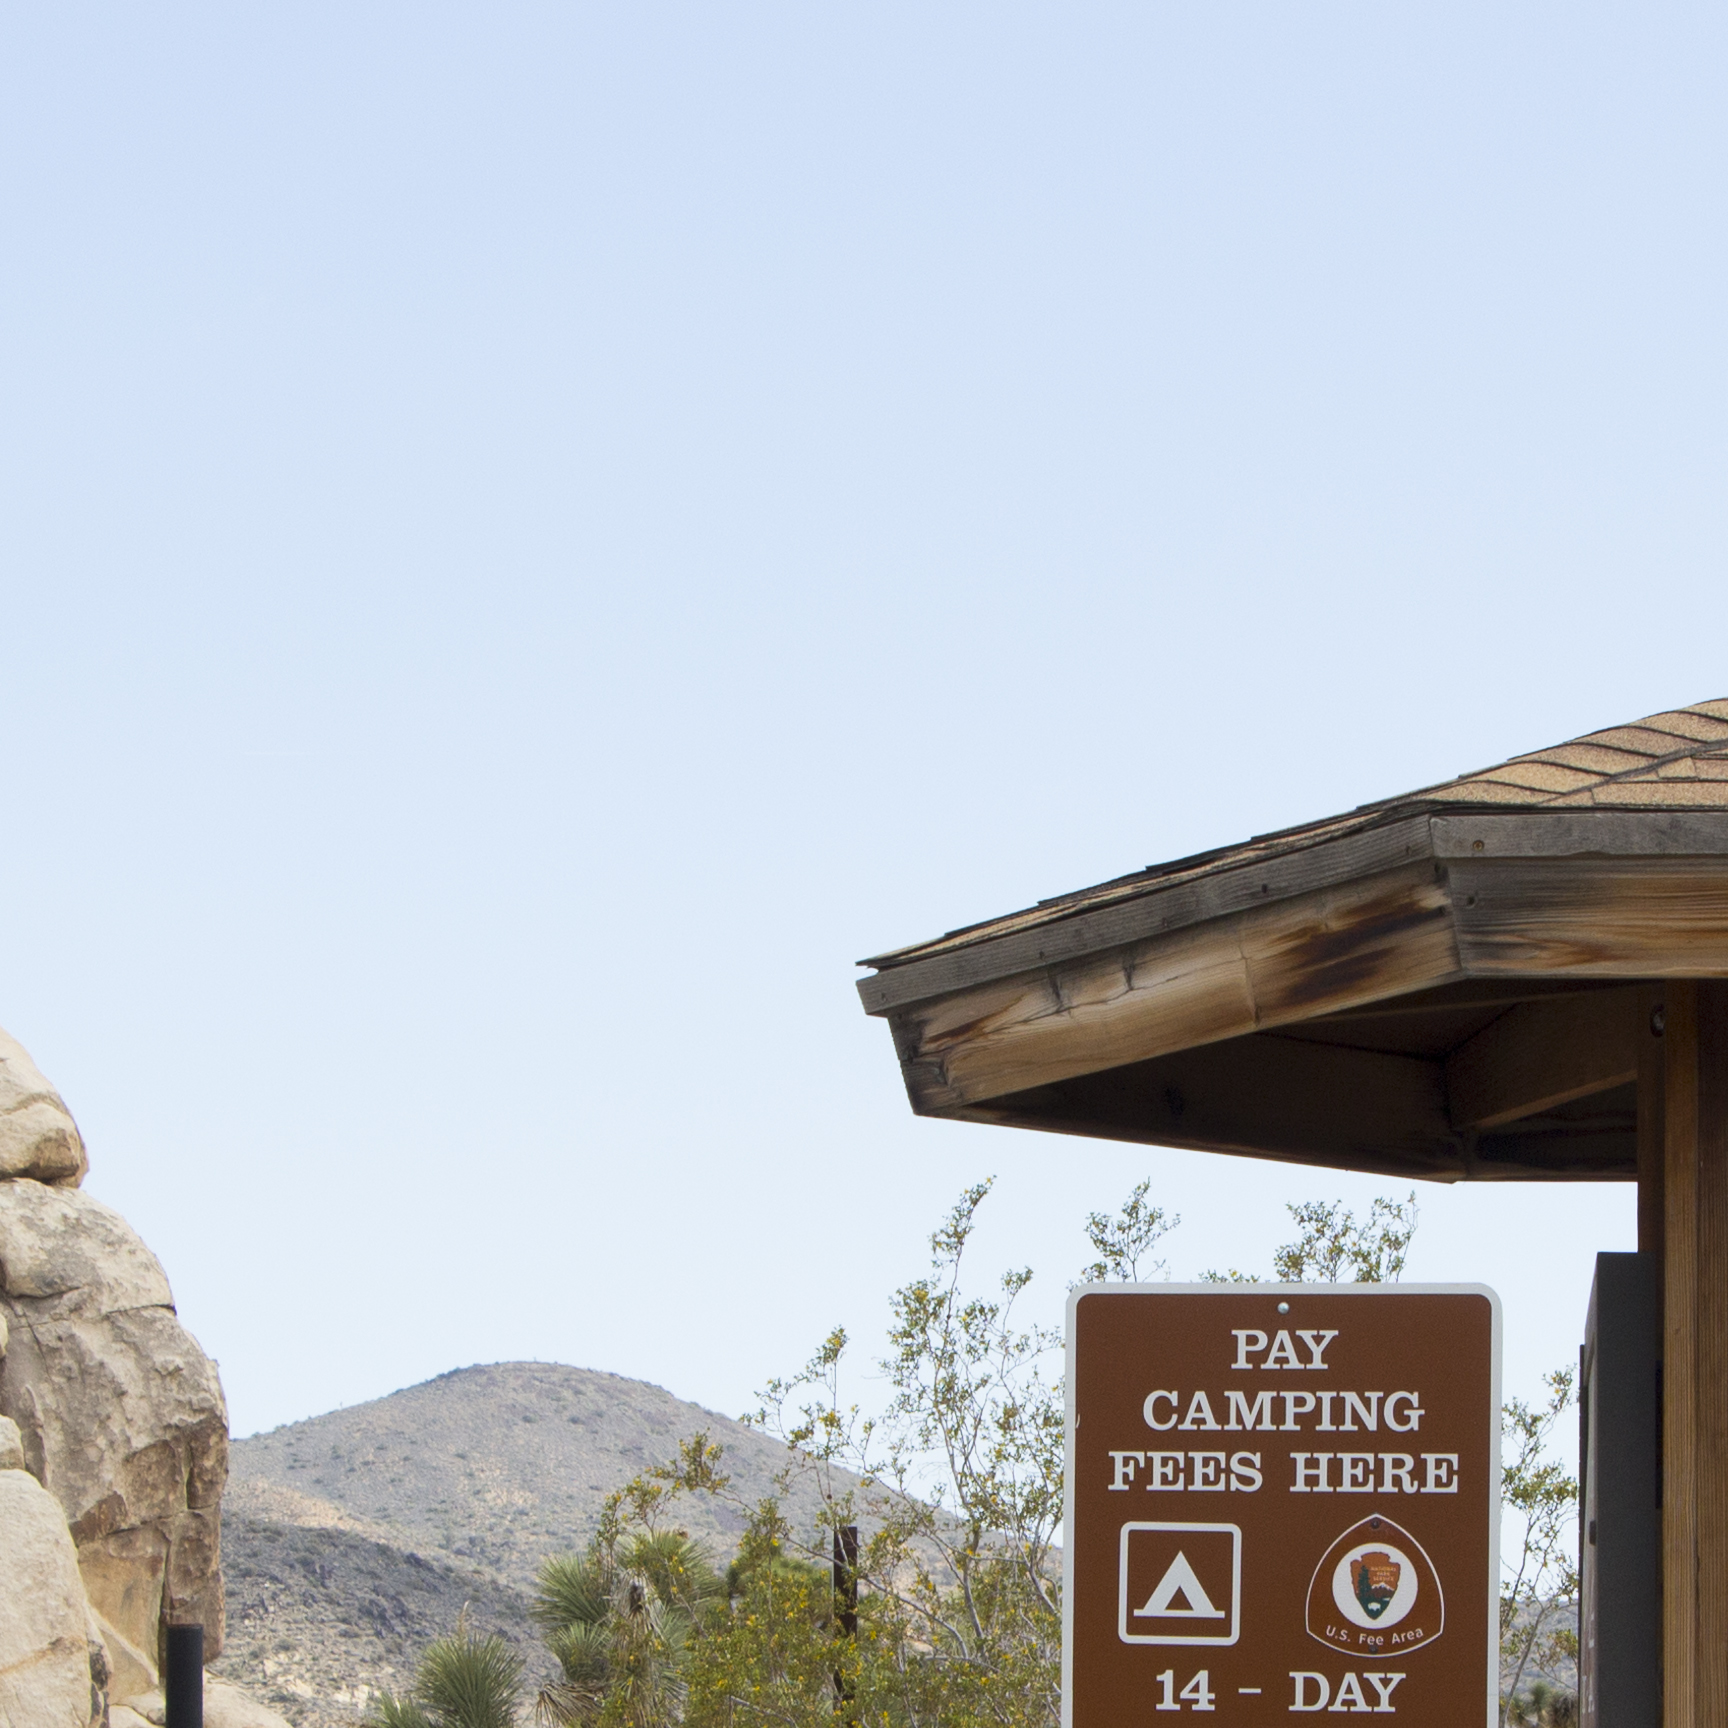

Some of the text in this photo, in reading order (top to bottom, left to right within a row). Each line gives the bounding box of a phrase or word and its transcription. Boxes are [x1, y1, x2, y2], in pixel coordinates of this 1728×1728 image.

[1231, 1329, 1338, 1369] PAY
[1142, 1389, 1425, 1432] CAMPING
[1107, 1450, 1458, 1493] FEES HERE
[1326, 1625, 1423, 1645] U.S. Fee Area
[1155, 1669, 1215, 1710] 14
[1288, 1671, 1406, 1711] DAY
